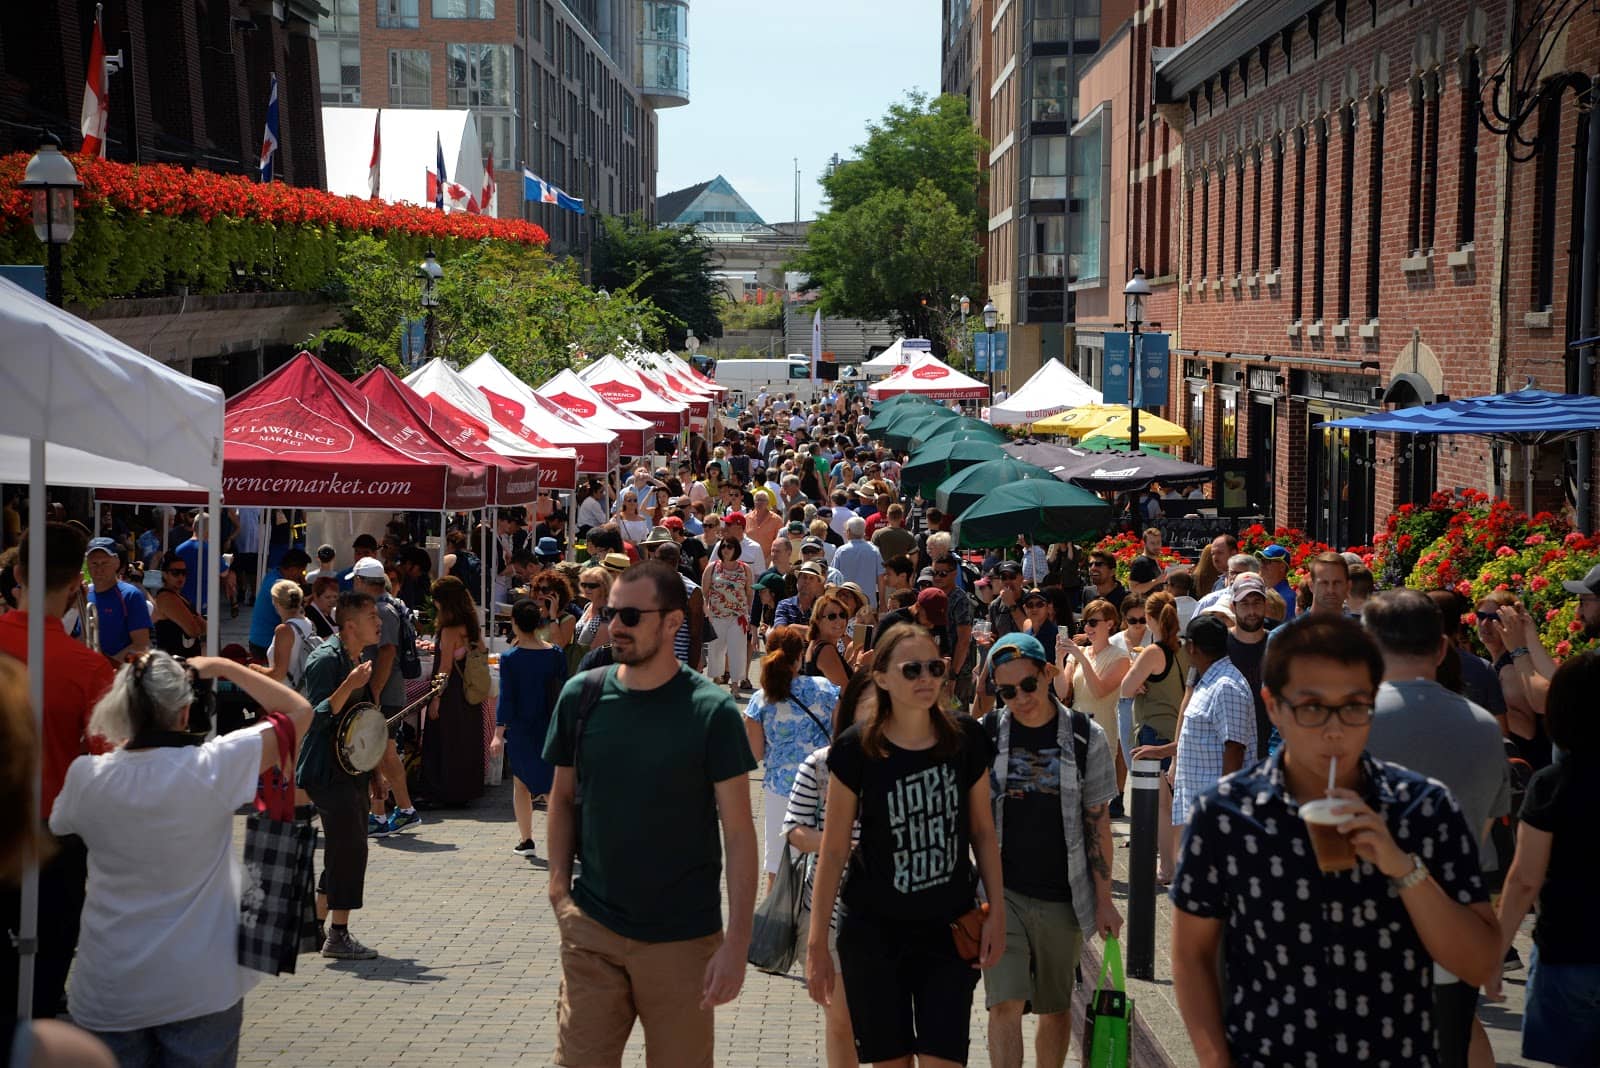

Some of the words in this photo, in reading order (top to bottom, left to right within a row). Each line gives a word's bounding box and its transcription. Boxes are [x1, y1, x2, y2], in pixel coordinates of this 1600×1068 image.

[250, 425, 336, 446] LAWRENCE
[259, 435, 305, 447] MARKET
[887, 763, 959, 827] WORK
[891, 809, 959, 851] THAT
[893, 833, 958, 894] BODY
